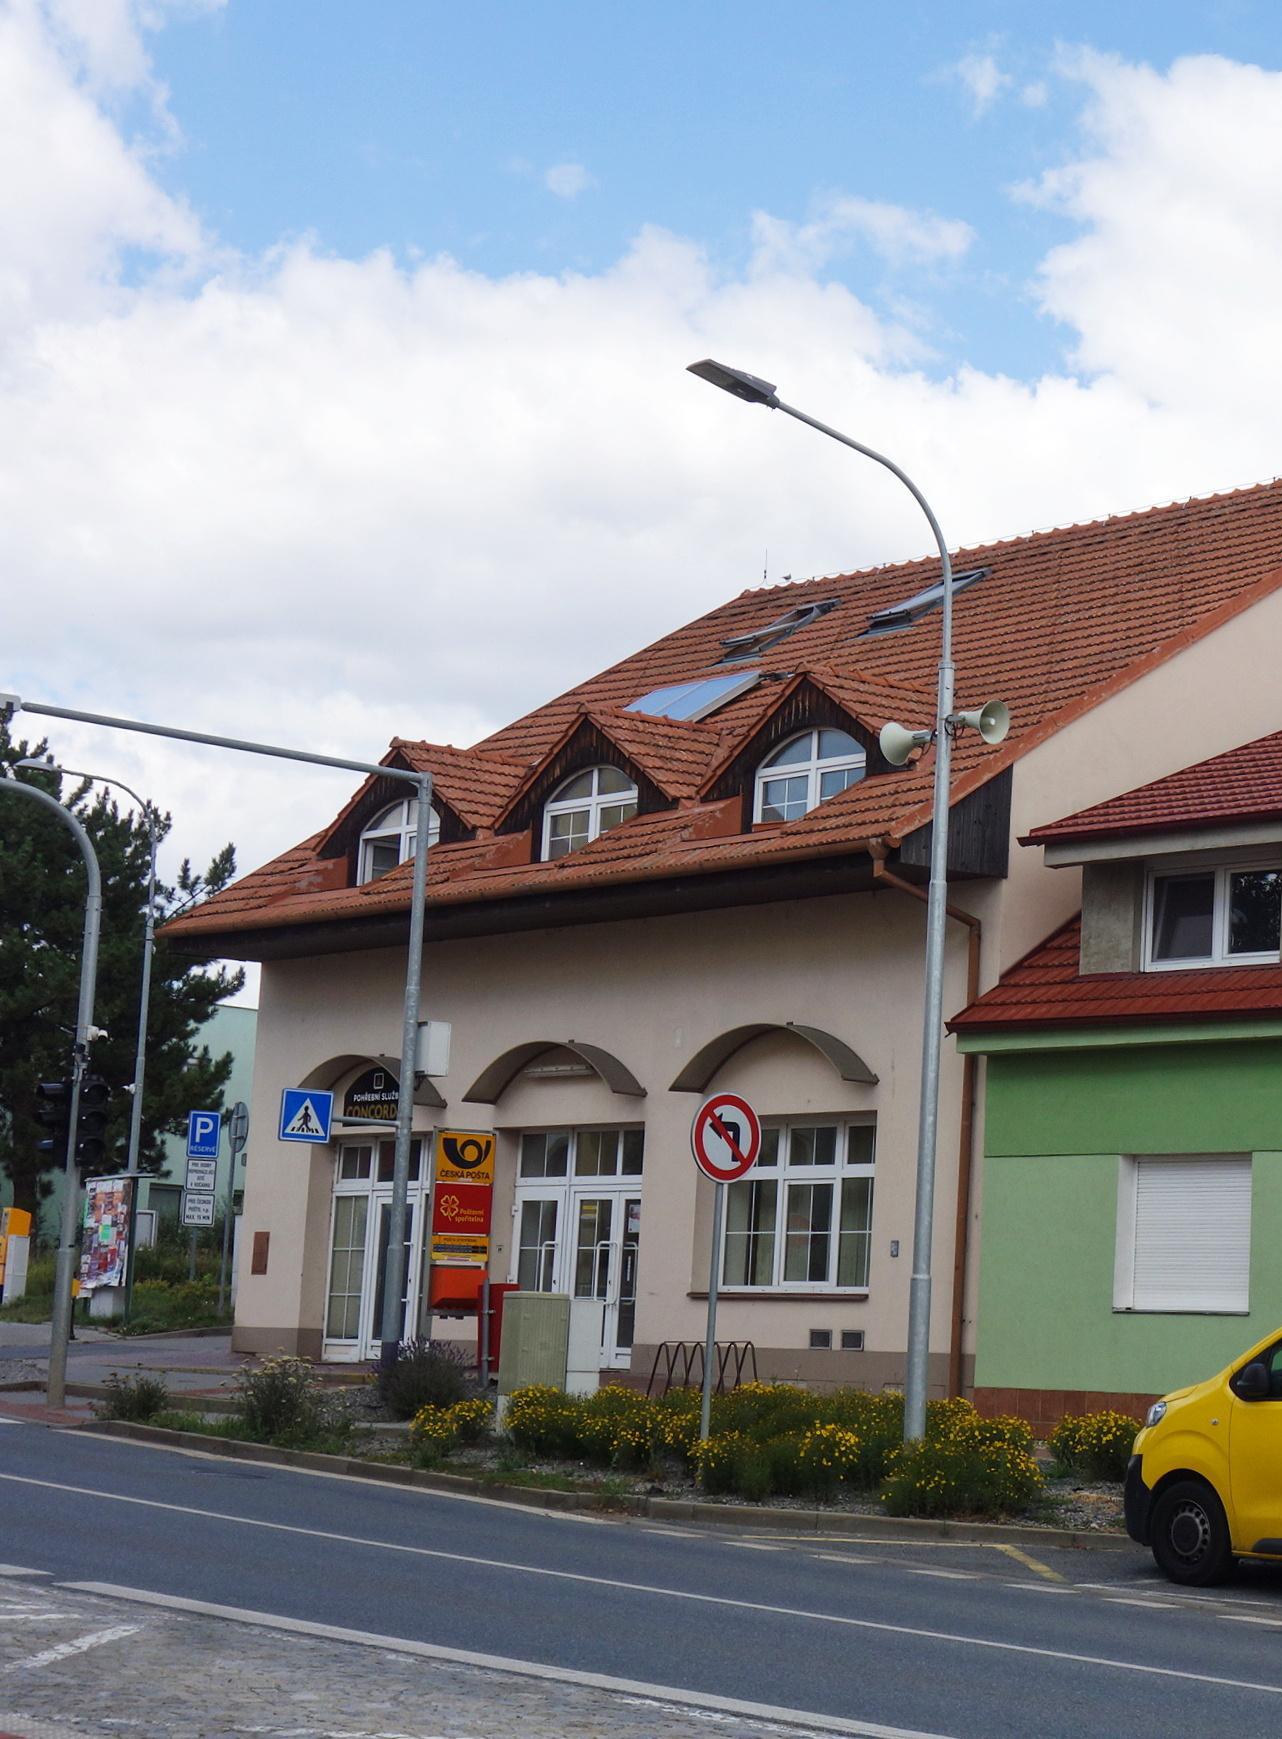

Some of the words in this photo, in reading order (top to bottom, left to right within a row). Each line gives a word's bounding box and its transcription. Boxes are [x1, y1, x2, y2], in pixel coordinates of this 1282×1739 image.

[381, 1090, 399, 1101] SLUŽB
[346, 1104, 397, 1119] CONCORD
[195, 1117, 214, 1143] P
[440, 1168, 465, 1178] ČESKÁ
[466, 1170, 490, 1180] POŠTA
